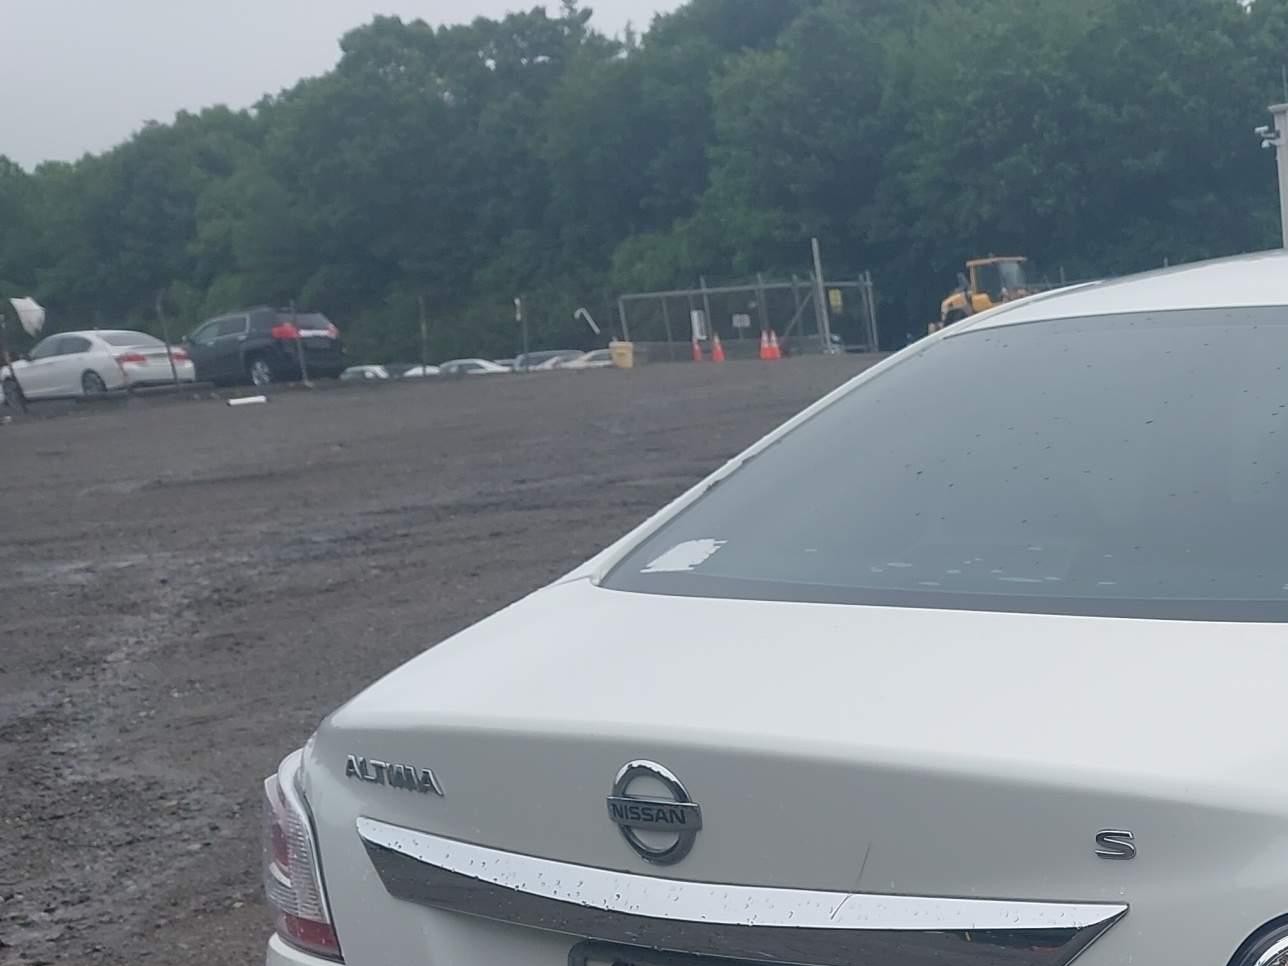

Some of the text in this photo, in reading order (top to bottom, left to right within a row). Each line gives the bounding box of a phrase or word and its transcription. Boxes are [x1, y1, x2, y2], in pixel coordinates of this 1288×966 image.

[345, 754, 444, 796] ALTIMA
[611, 803, 687, 825] NISSAN
[1095, 829, 1136, 861] S
